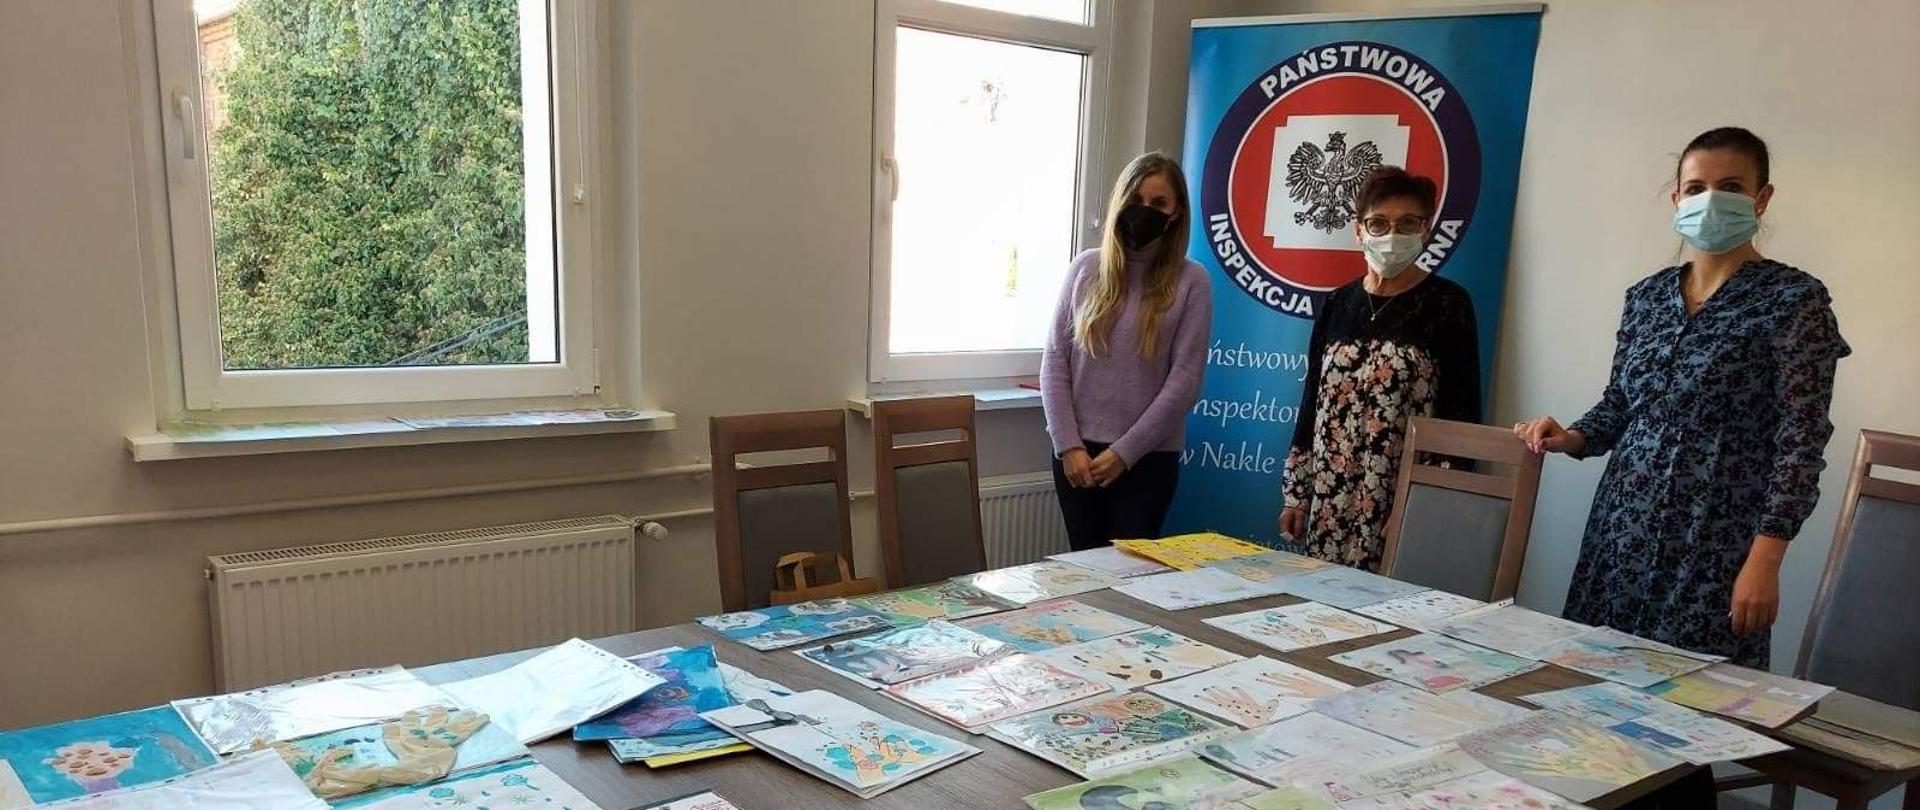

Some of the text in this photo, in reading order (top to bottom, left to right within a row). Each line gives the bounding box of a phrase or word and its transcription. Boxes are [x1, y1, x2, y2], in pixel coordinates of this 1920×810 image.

[1259, 46, 1446, 112] PAŃSTWOWA
[1210, 213, 1313, 316] INSPEKCJA
[1207, 339, 1309, 382] ństwowy
[1201, 441, 1276, 474] Nakle
